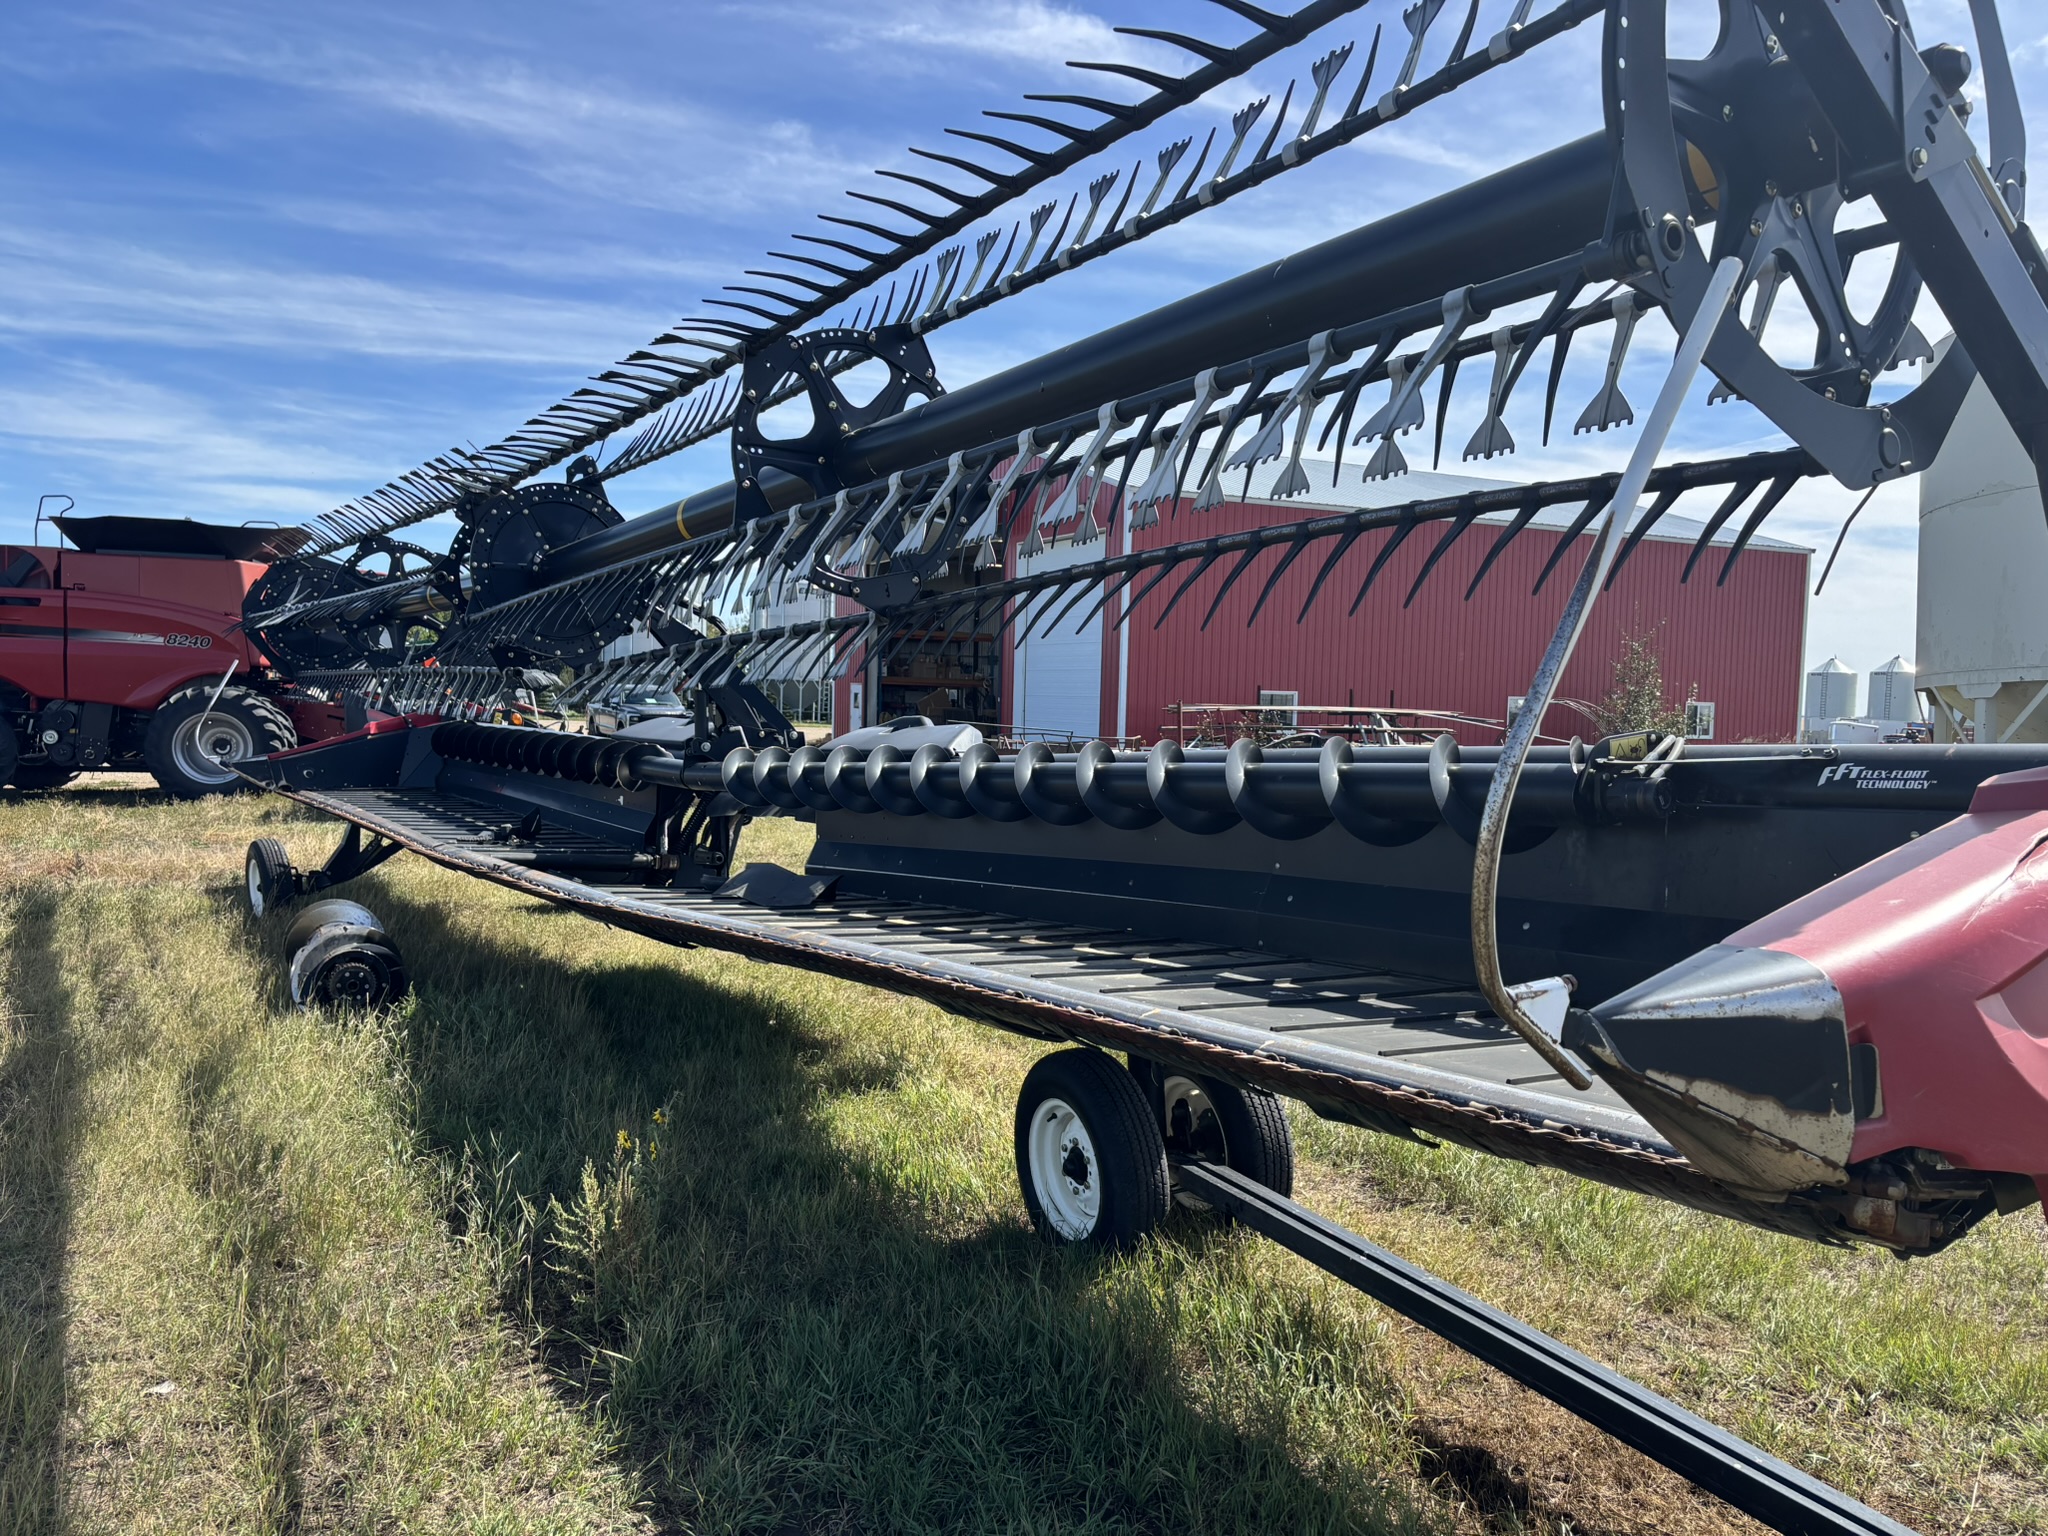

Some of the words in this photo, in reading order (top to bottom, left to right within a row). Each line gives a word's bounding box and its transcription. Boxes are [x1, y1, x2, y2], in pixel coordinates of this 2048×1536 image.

[165, 633, 212, 649] 8240
[1817, 763, 1866, 787] FFT
[1860, 770, 1930, 779] FLEX-FLOAT
